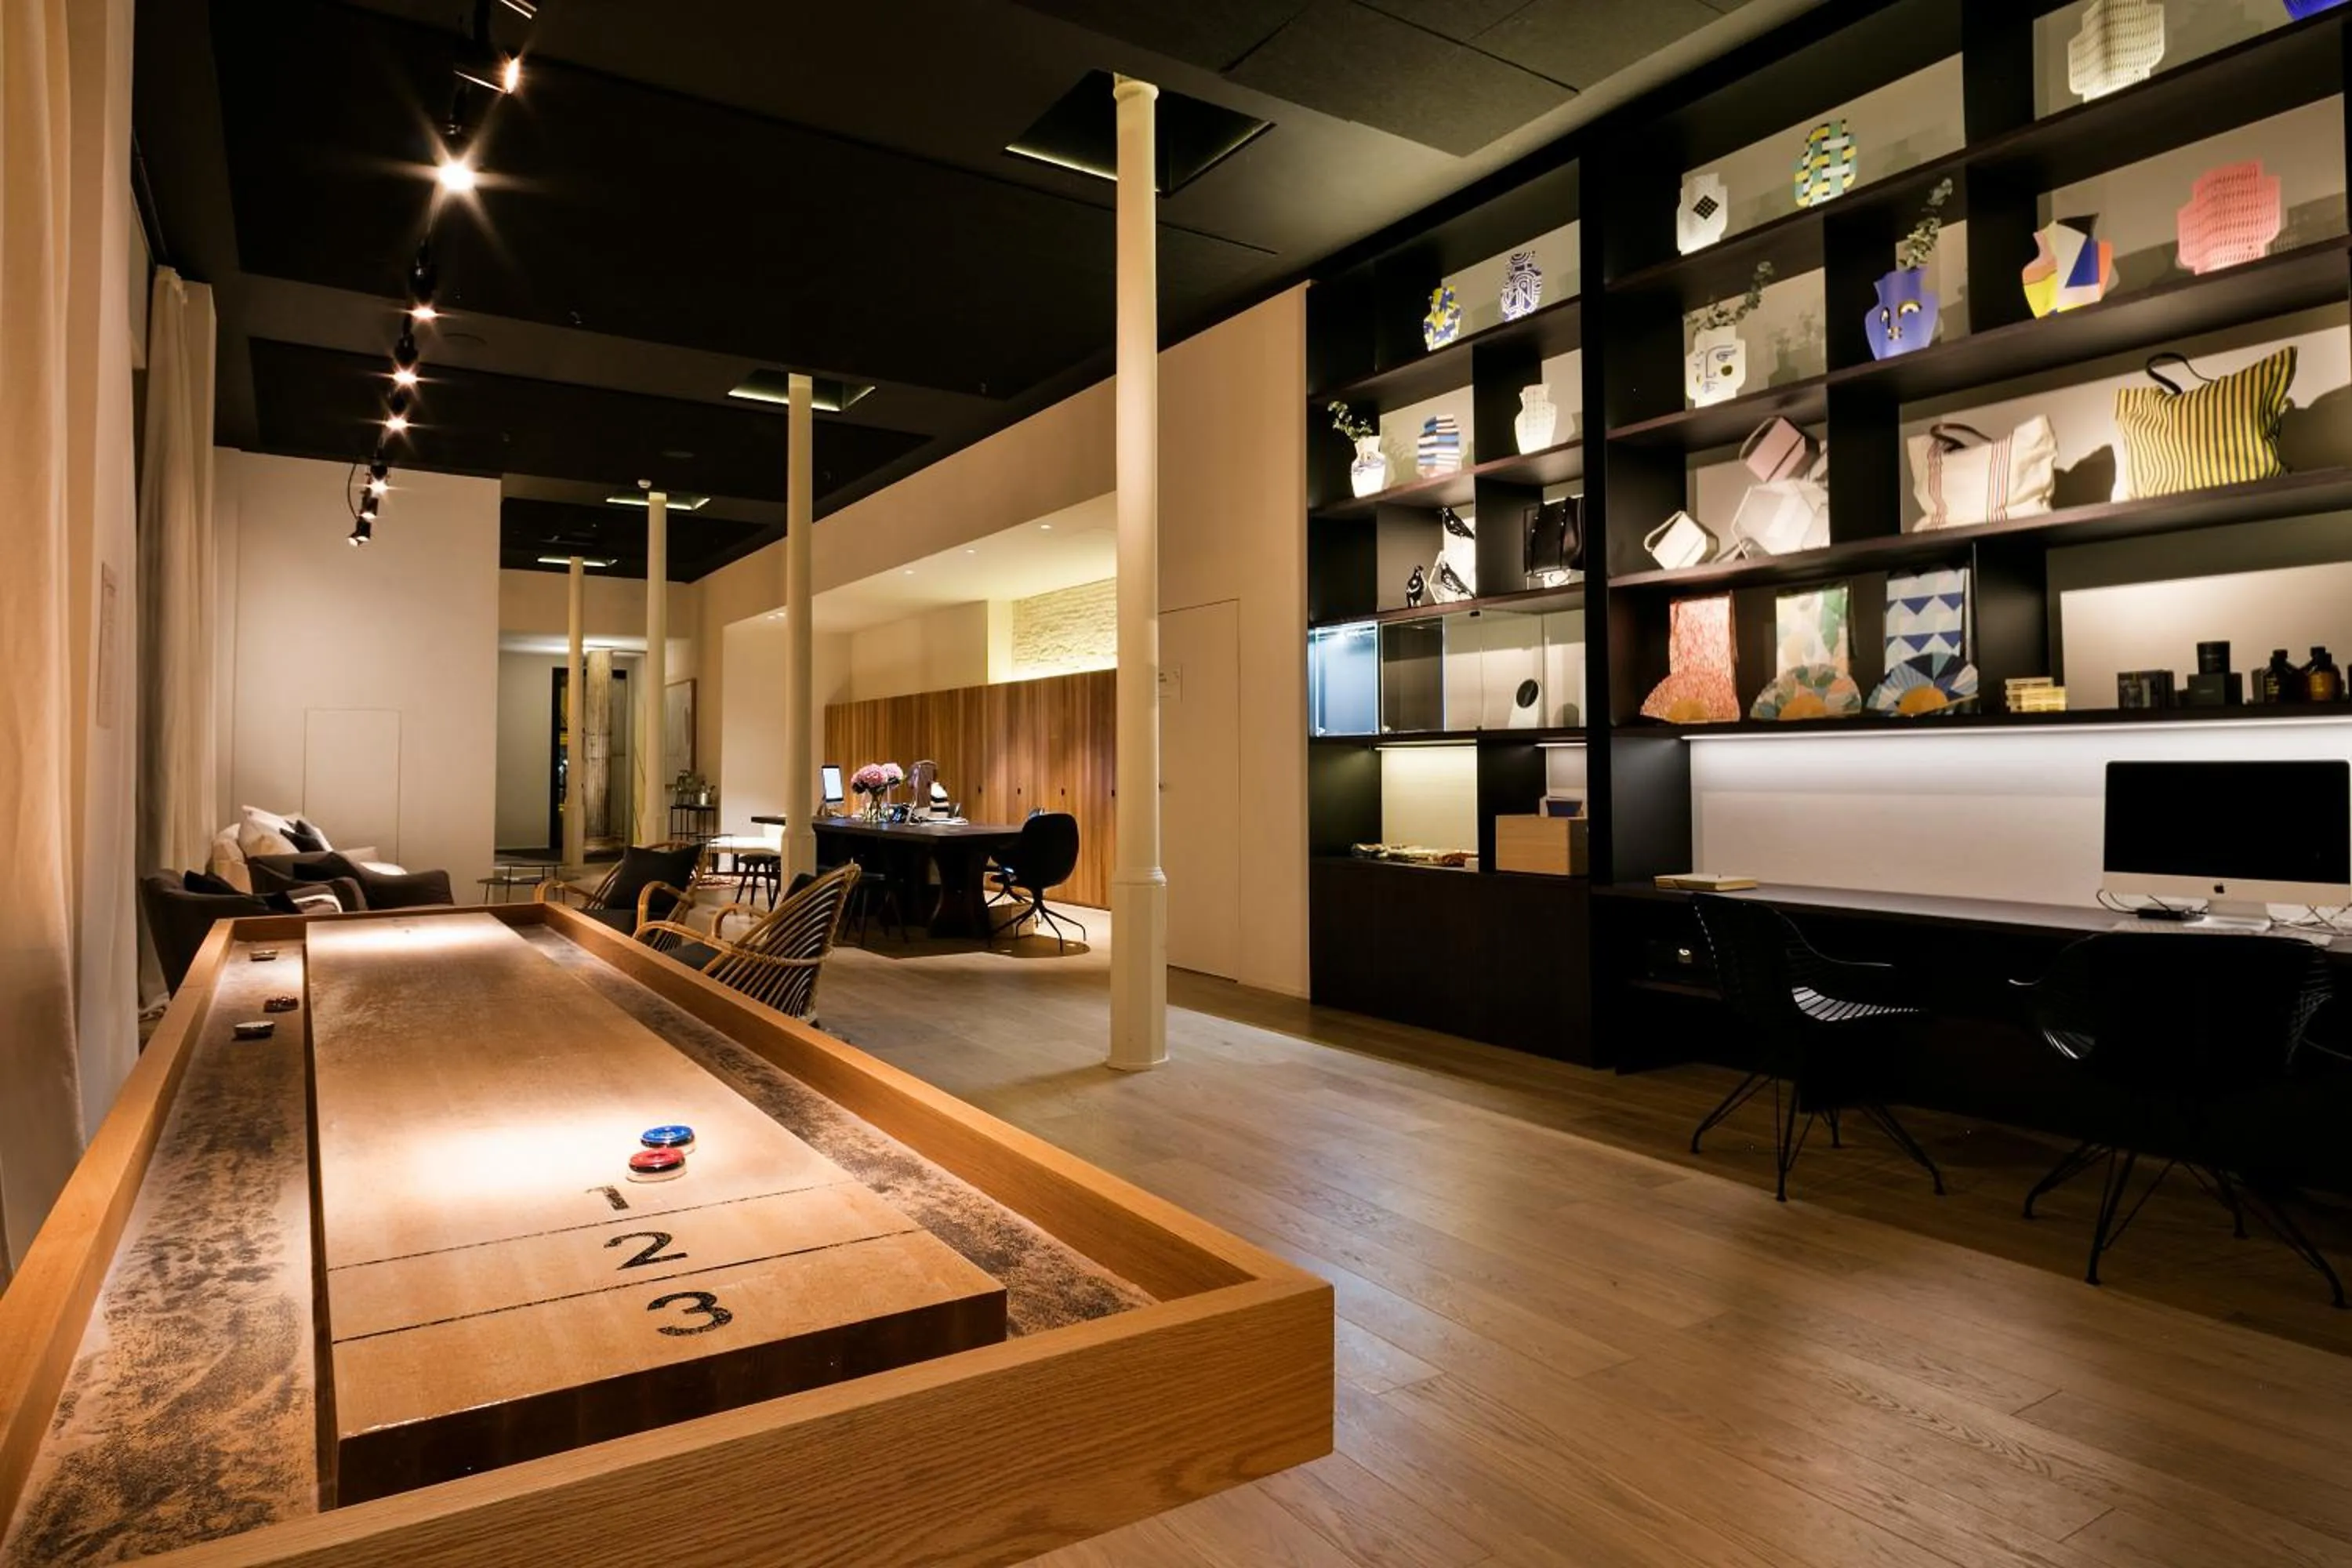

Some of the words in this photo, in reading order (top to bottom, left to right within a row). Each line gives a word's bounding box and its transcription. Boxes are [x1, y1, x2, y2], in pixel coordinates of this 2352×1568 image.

[585, 1185, 630, 1210] 1
[603, 1232, 688, 1271] 2
[647, 1291, 733, 1336] 3
